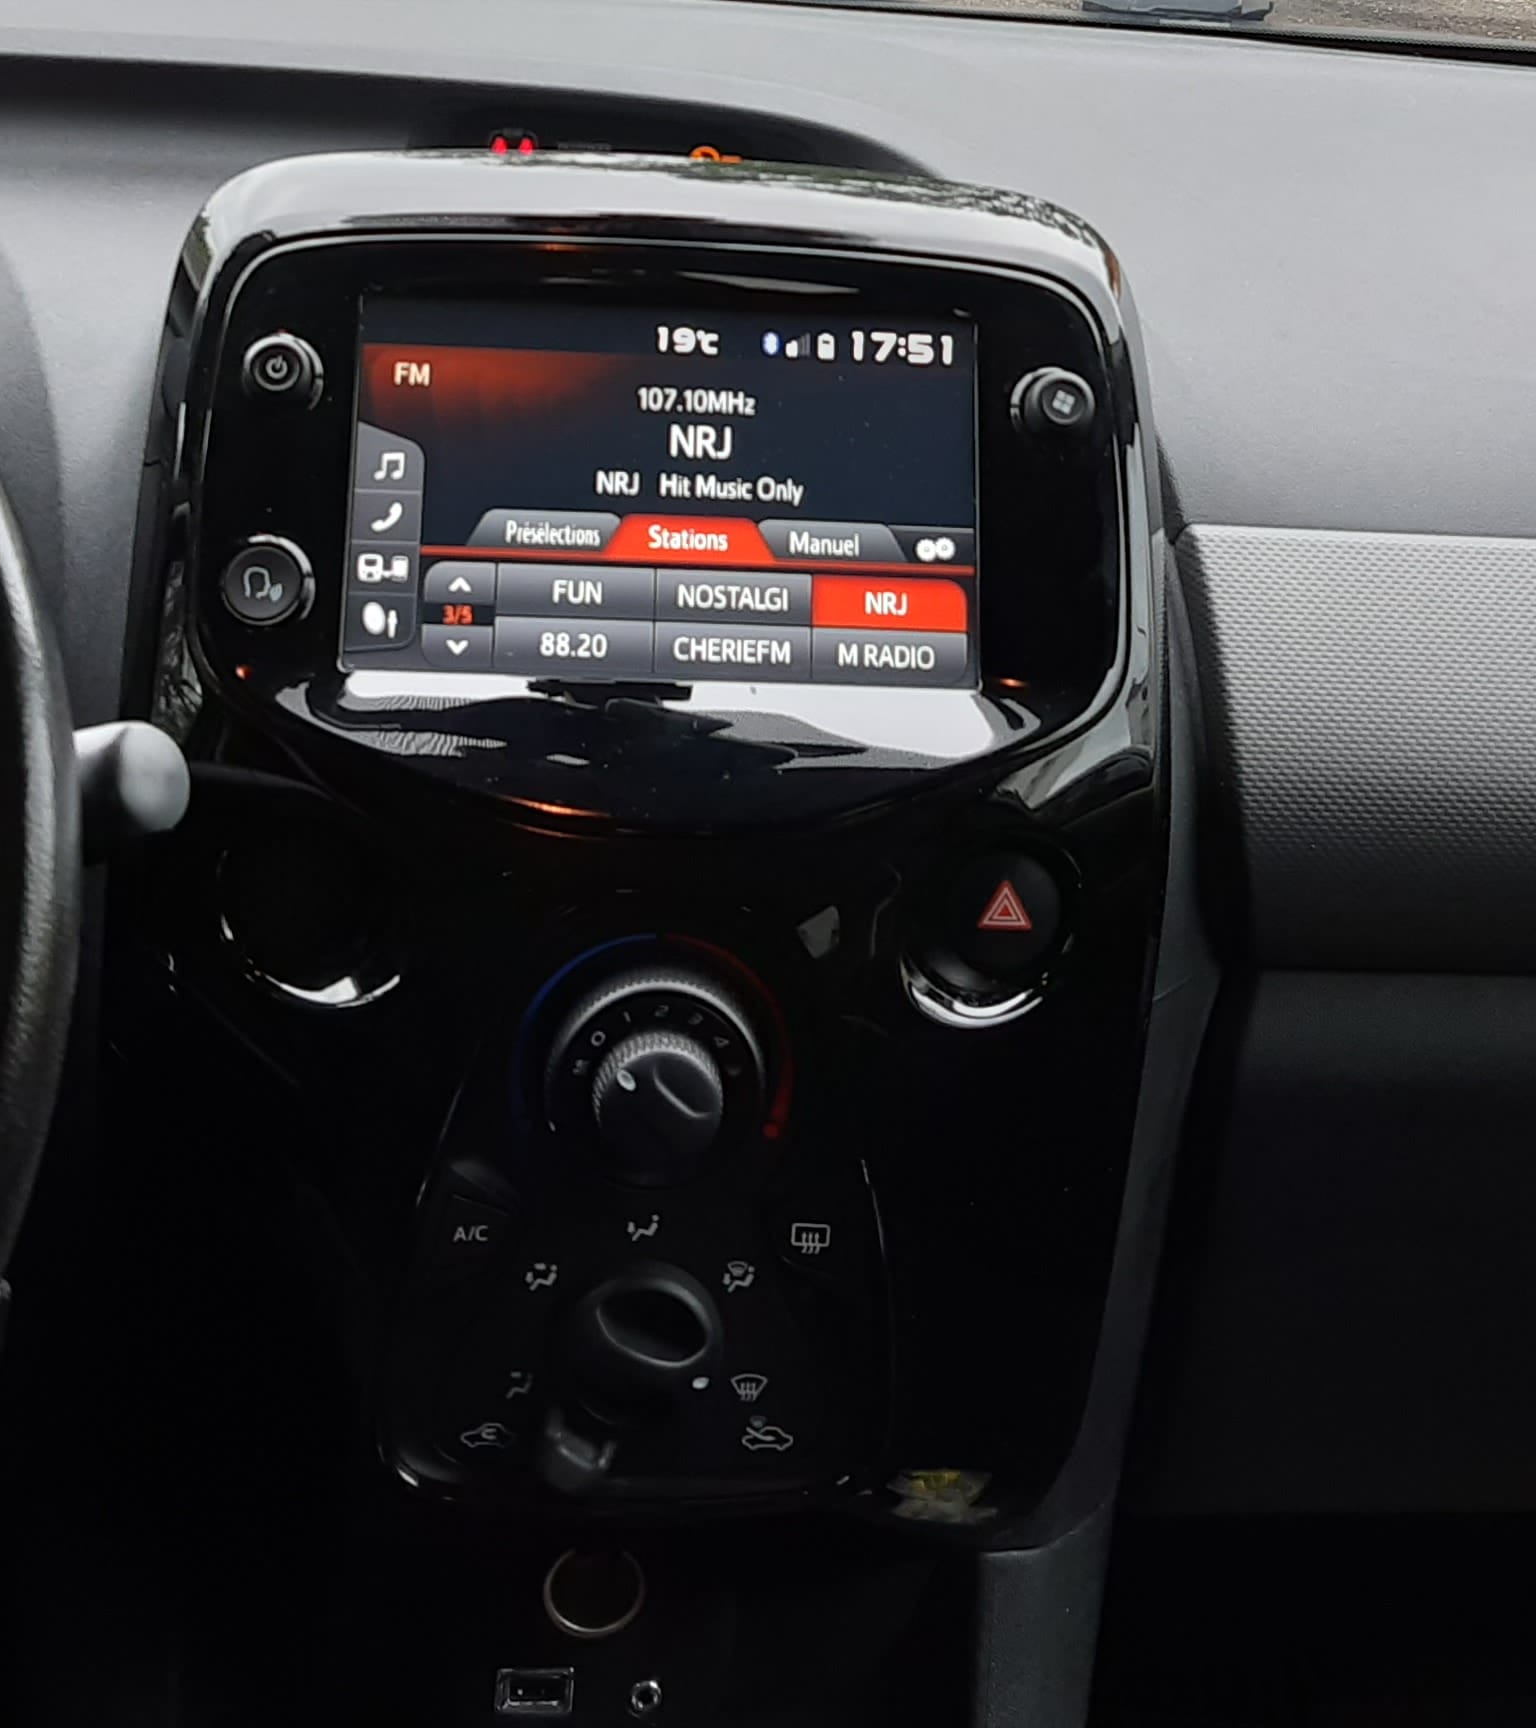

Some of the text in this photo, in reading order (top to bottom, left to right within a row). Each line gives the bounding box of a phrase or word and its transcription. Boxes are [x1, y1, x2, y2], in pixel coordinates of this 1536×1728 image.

[851, 330, 954, 366] 17:51
[393, 361, 432, 387] FM
[637, 387, 757, 416] 107.10MHz
[668, 423, 733, 460] NRJ
[595, 470, 805, 507] NRJ Hit Music Only
[505, 519, 601, 547] Présélections
[648, 524, 729, 552] Stations
[789, 530, 860, 557] Manuel
[552, 579, 603, 605] FUN
[677, 583, 789, 612] NOSTALGI
[864, 591, 908, 616] NRJ
[442, 604, 474, 626] 3/5
[539, 631, 608, 659] 88.20
[672, 636, 792, 665] CHERIEFM
[837, 642, 936, 670] M RADIO
[453, 1224, 489, 1242] A/C
